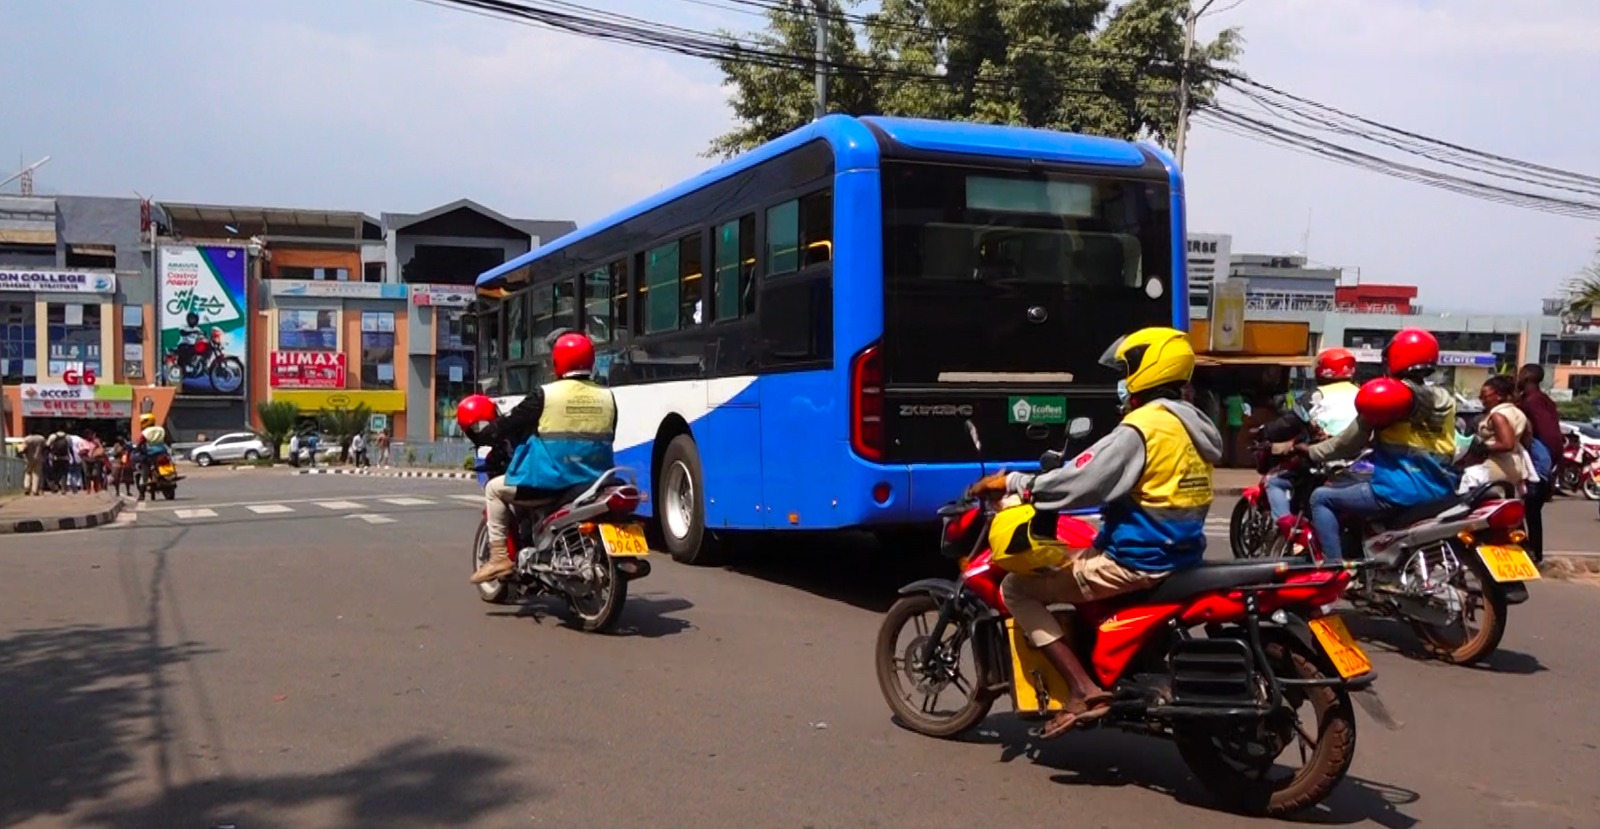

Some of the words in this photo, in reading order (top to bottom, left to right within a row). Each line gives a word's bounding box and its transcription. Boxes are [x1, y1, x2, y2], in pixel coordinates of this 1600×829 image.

[21, 273, 86, 284] COLLEGE
[275, 352, 340, 366] HIMAX
[40, 388, 81, 398] access
